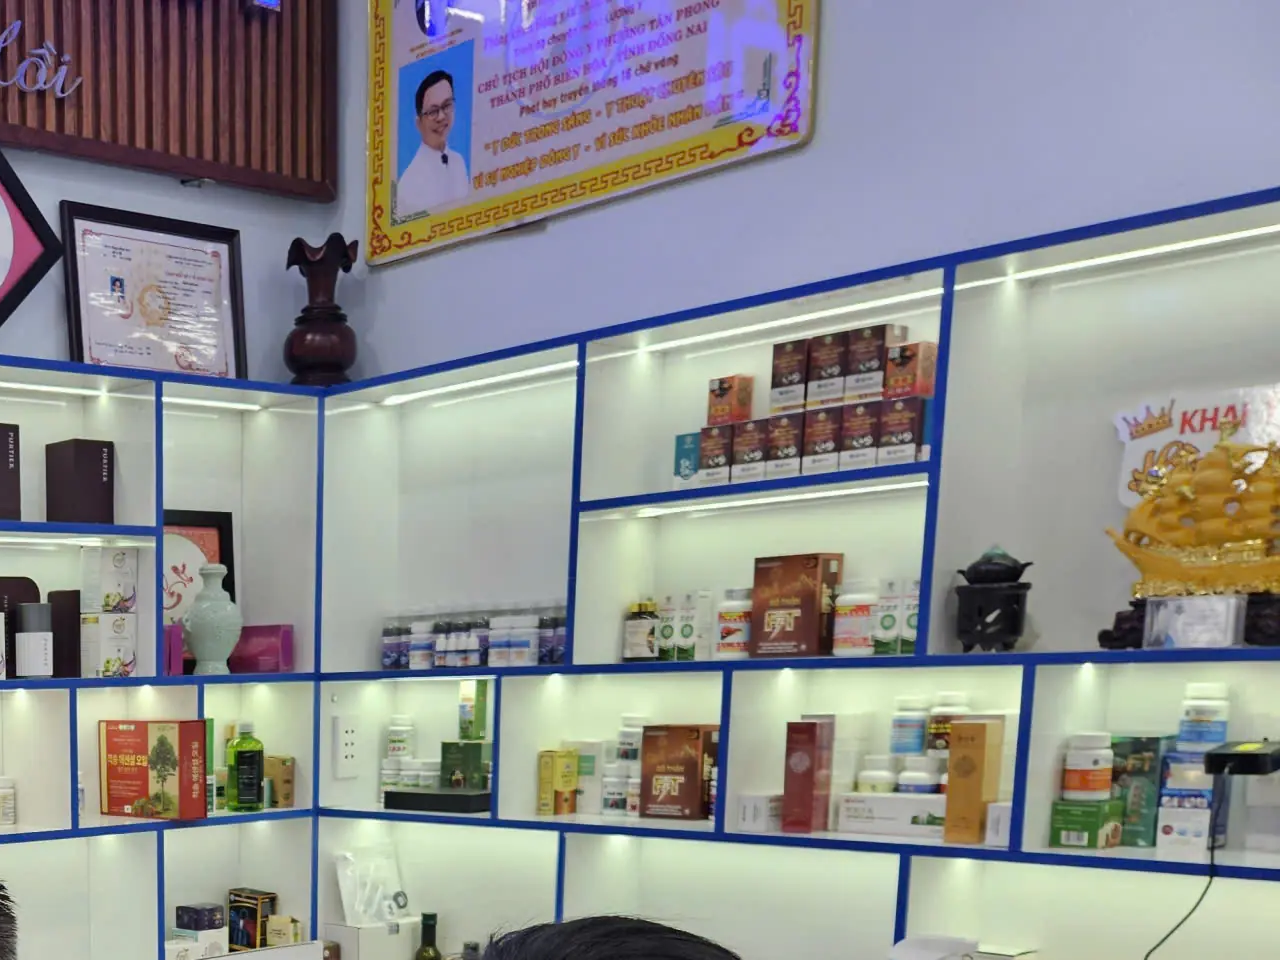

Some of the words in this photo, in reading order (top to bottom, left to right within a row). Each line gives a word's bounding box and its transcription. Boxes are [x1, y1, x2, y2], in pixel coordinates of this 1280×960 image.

[478, 78, 499, 94] CHỦ
[502, 72, 527, 88] TỊCH
[529, 61, 550, 79] HỘI
[650, 13, 673, 32] TÂN
[675, 0, 720, 22] PHONG
[490, 89, 526, 109] THÀNH
[528, 78, 551, 100] PHỐ
[647, 28, 682, 54] ĐỒNG
[685, 20, 708, 38] NAI
